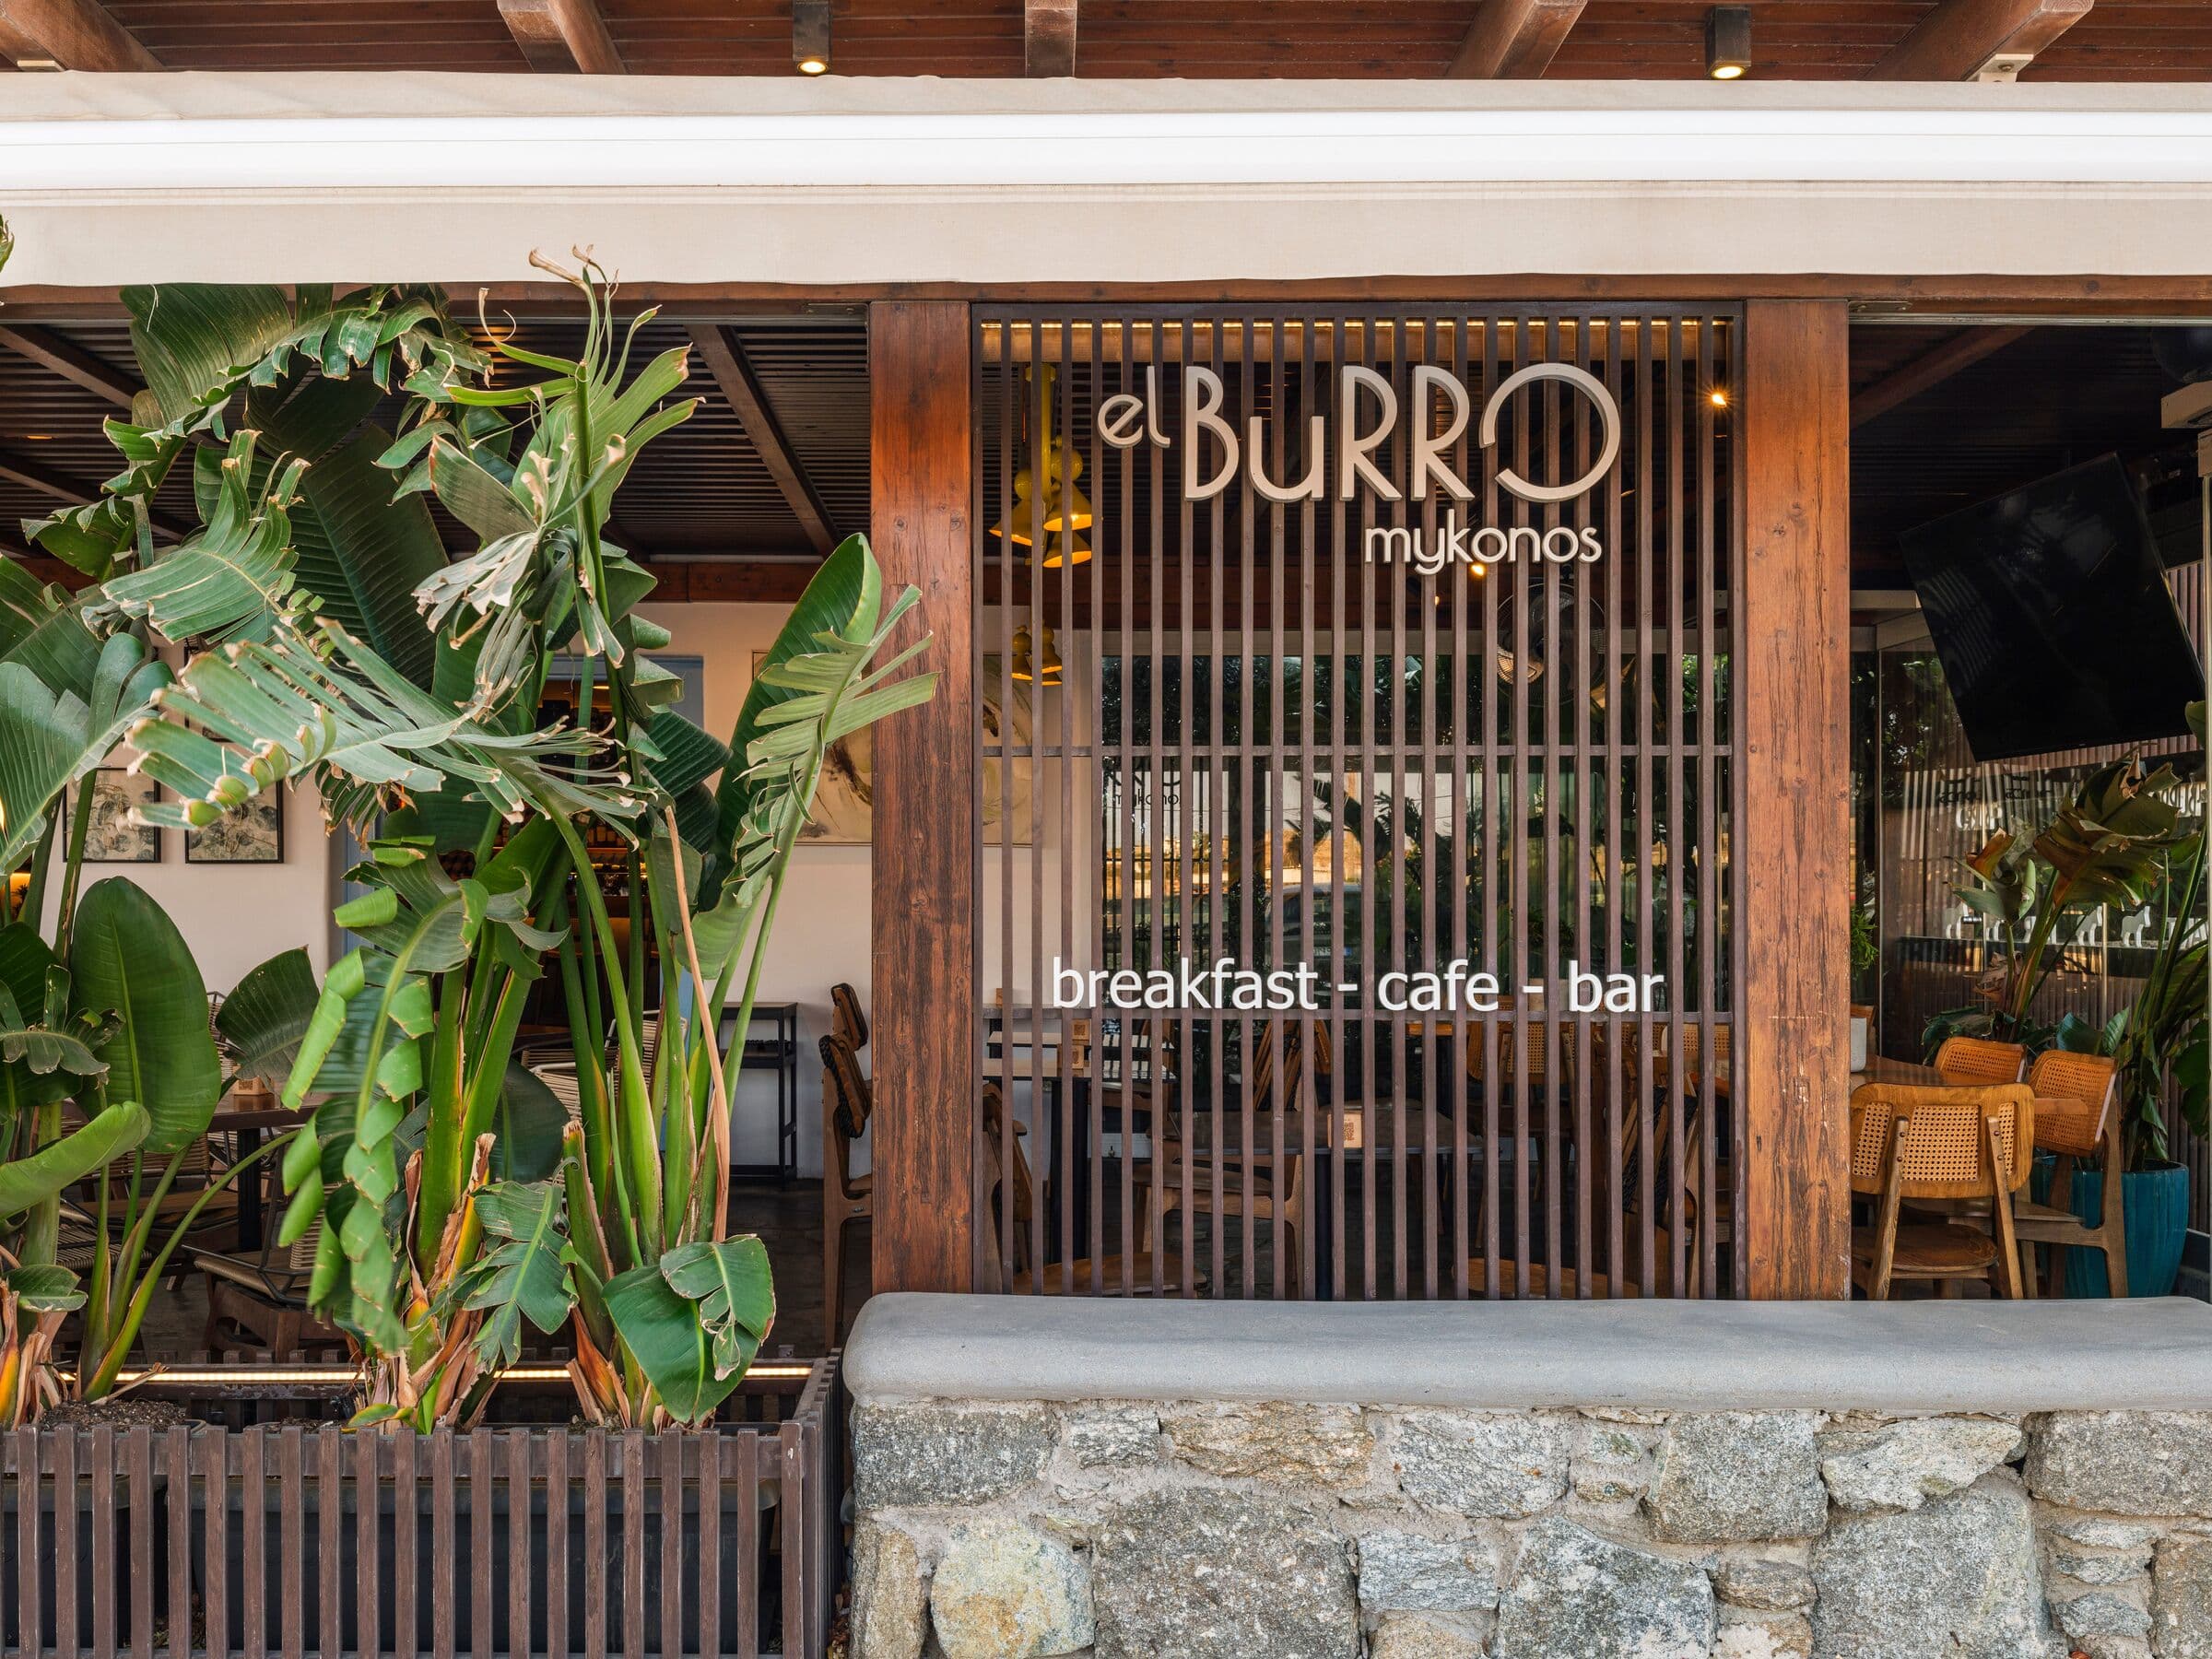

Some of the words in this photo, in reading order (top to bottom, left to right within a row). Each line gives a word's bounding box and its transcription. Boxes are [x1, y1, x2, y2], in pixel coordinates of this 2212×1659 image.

[1364, 508, 1602, 574] mykonos
[1052, 957, 1318, 1010] breakfast
[1377, 959, 1500, 1012] cafe
[1569, 959, 1665, 1013] bar
